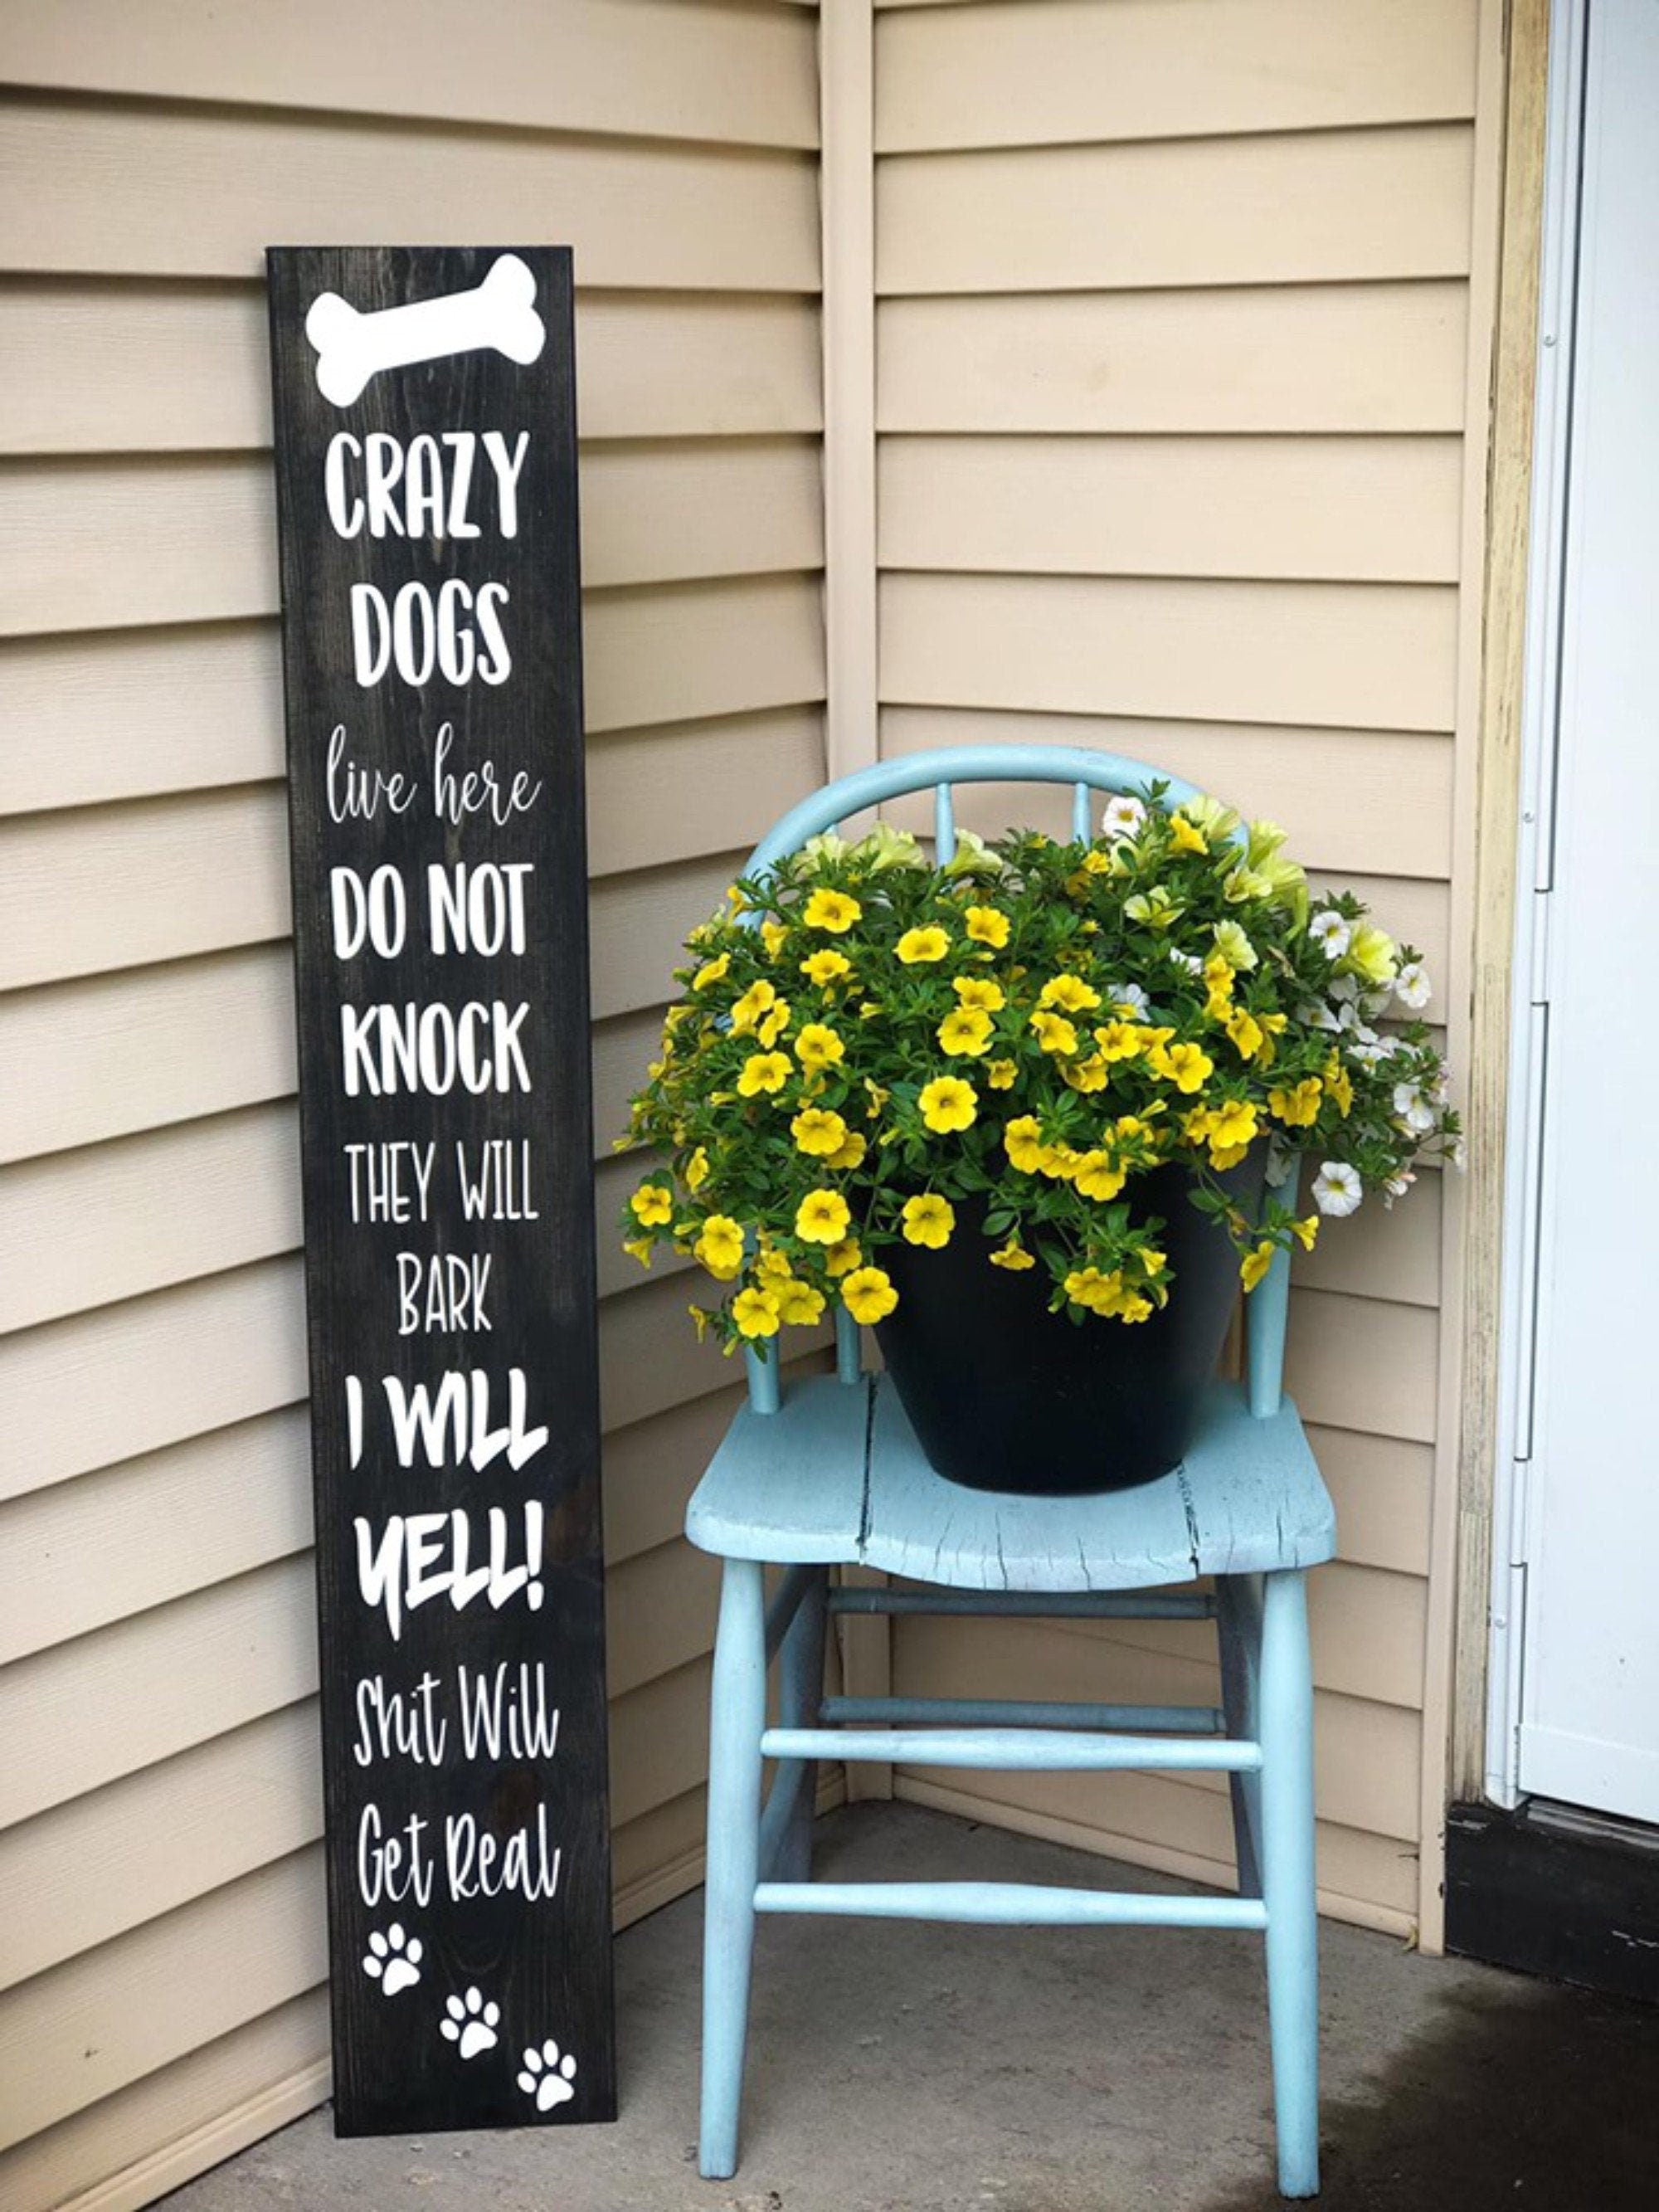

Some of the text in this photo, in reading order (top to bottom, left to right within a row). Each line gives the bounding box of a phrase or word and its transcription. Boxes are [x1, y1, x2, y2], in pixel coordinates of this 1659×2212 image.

[325, 431, 530, 539] CRAZY
[350, 578, 512, 688] DOGS
[327, 722, 542, 826] live here
[330, 862, 534, 960] DO NOT
[341, 1001, 532, 1096] KNOCK
[343, 1139, 539, 1224] THEY WILL
[396, 1252, 493, 1335] BARK
[345, 1367, 549, 1473] I WILL
[353, 1499, 544, 1641] YELL!
[458, 1662, 560, 1760] Will
[358, 1802, 561, 1907] Get Real
